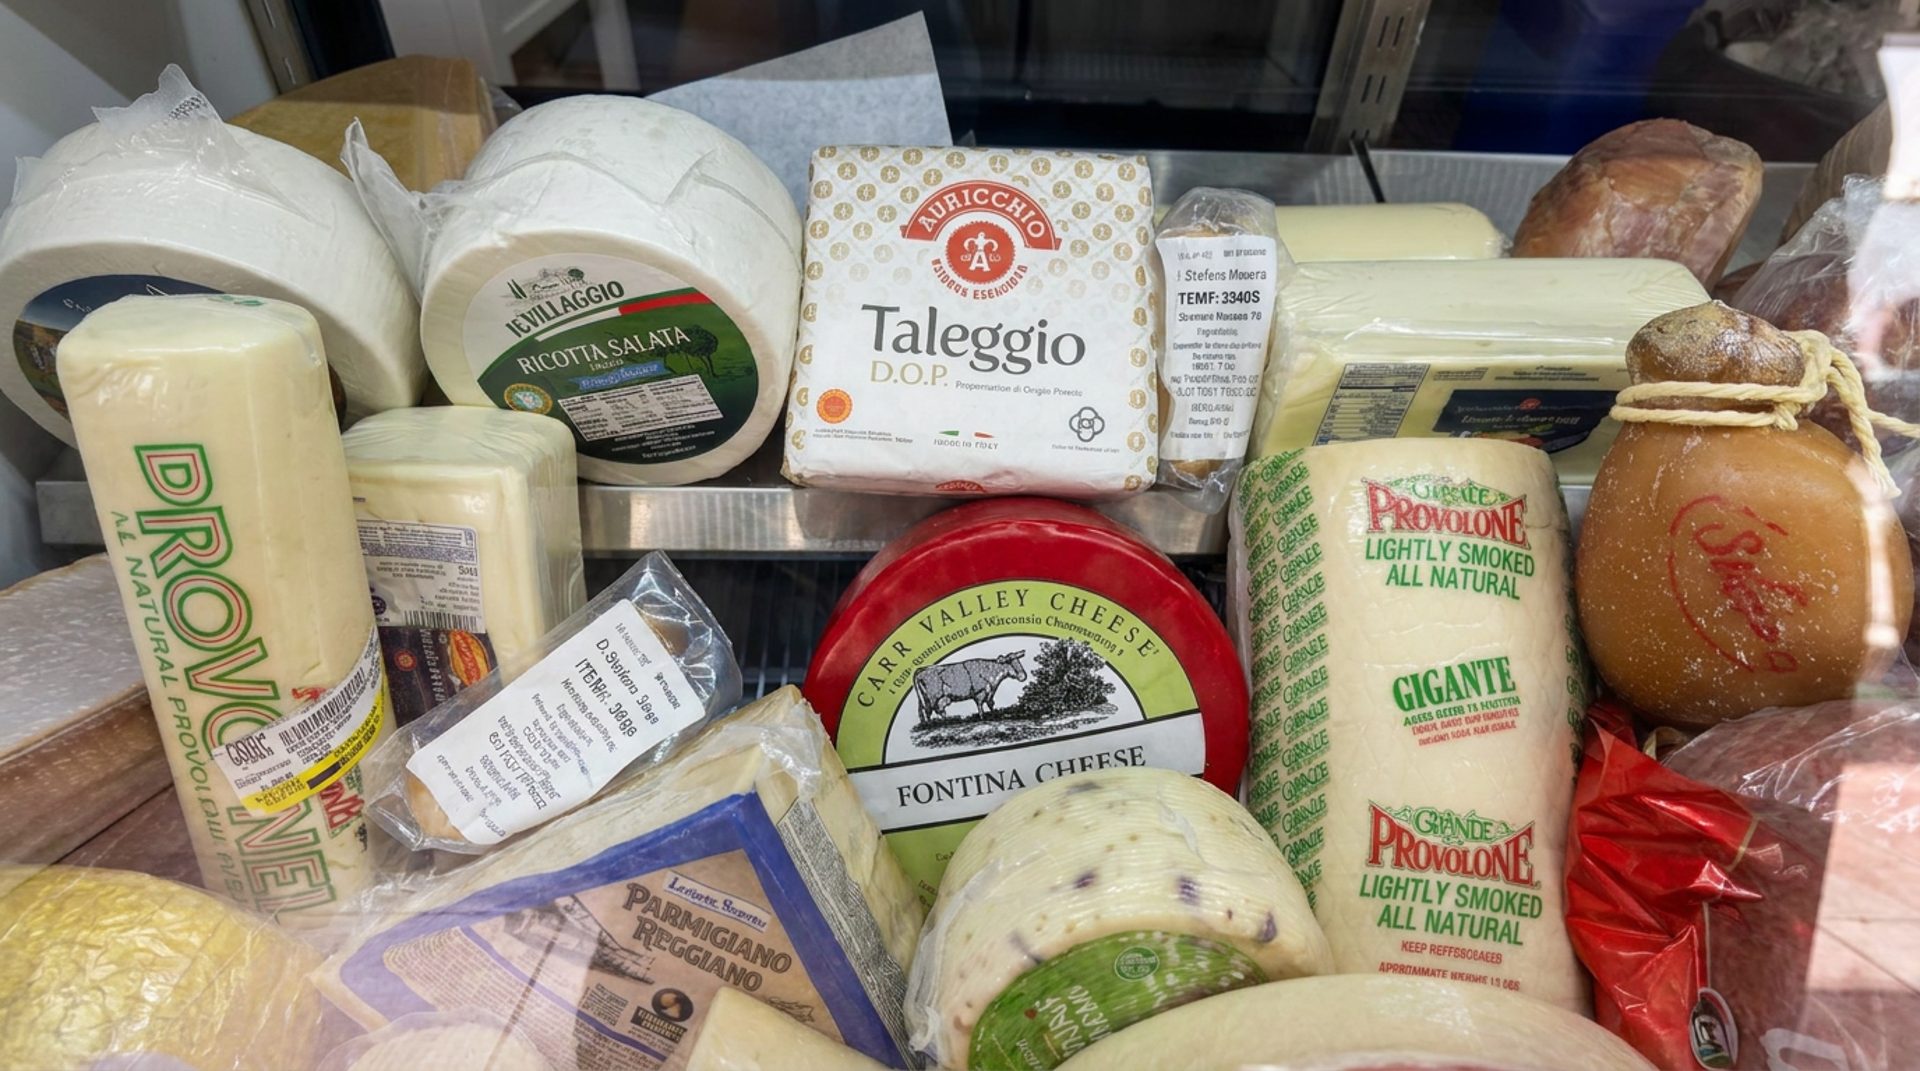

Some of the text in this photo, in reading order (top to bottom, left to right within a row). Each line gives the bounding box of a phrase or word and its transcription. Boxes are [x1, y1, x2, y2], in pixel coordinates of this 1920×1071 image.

[918, 187, 1046, 239] AURICCHIO
[516, 343, 608, 375] RICOTTA
[611, 326, 691, 358] SALATA
[861, 303, 1086, 375] Taleggio
[870, 360, 949, 387] D.O.P.
[1366, 480, 1530, 548] PROVOLONE
[1365, 537, 1536, 578] LIGHTLY SMOKED
[1385, 563, 1521, 601] ALL NATURAL
[125, 556, 178, 689] NATURAL
[856, 640, 913, 708] CARR
[919, 588, 1031, 634] VALLEY
[1391, 655, 1517, 713] GIGANTE
[897, 767, 1026, 807] FONTINA
[1366, 801, 1536, 889] PROVOLONE
[1413, 808, 1494, 841] GRANDE
[1359, 874, 1544, 920] LIGHTLY SMOKED
[622, 881, 793, 975] PARMIGIANO
[1376, 903, 1524, 946] ALL NATURAL
[1401, 939, 1428, 954] KEEP
[632, 914, 763, 993] REGGIANO
